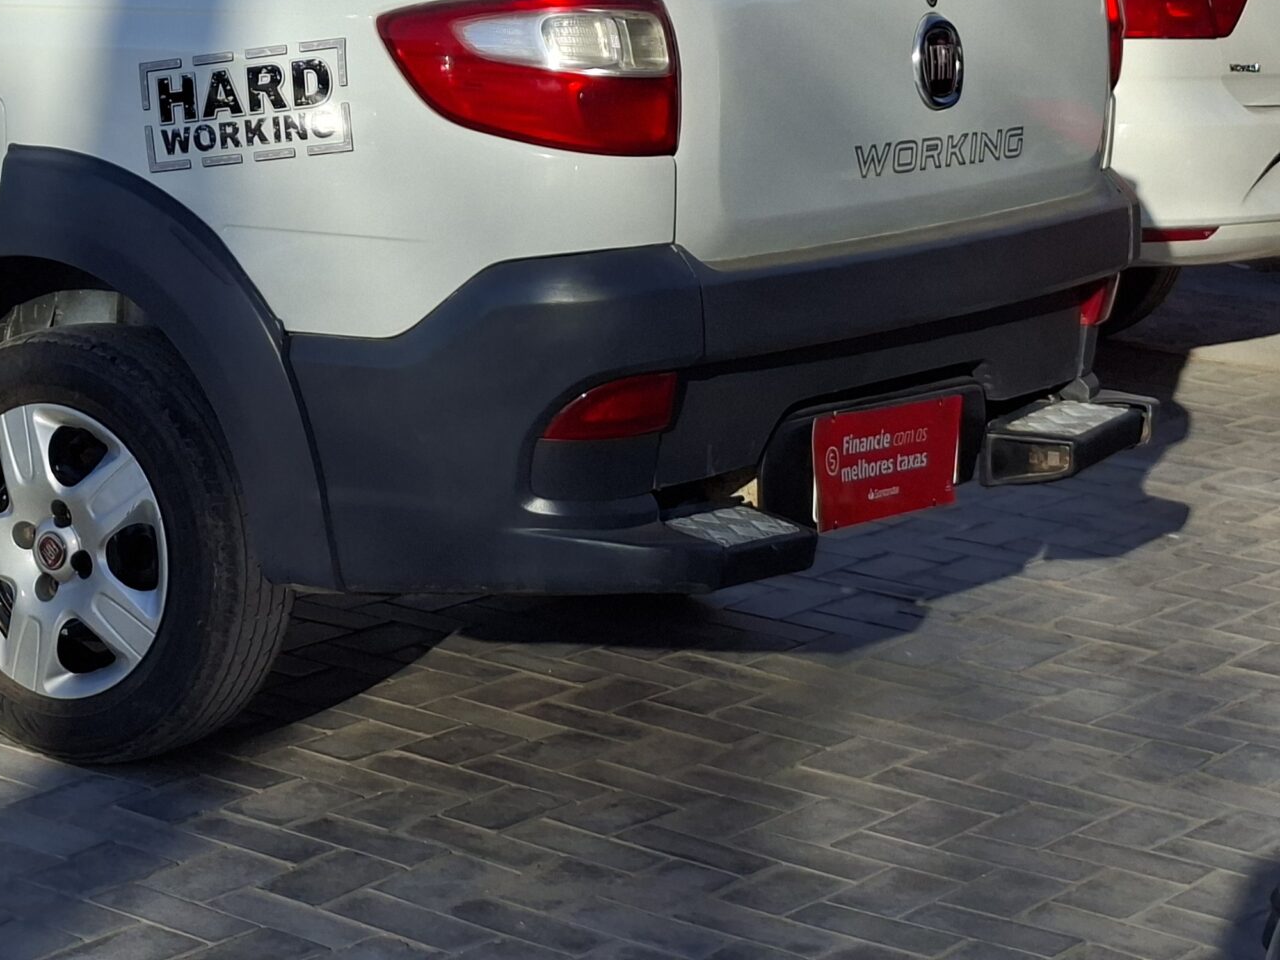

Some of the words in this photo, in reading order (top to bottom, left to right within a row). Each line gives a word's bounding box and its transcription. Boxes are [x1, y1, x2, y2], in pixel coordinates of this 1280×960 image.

[156, 56, 334, 126] HARD
[855, 126, 1024, 178] WORKING
[843, 429, 891, 455] Financie
[893, 430, 914, 446] com
[915, 427, 928, 443] os
[841, 458, 894, 482] melhores
[896, 452, 927, 471] taxas
